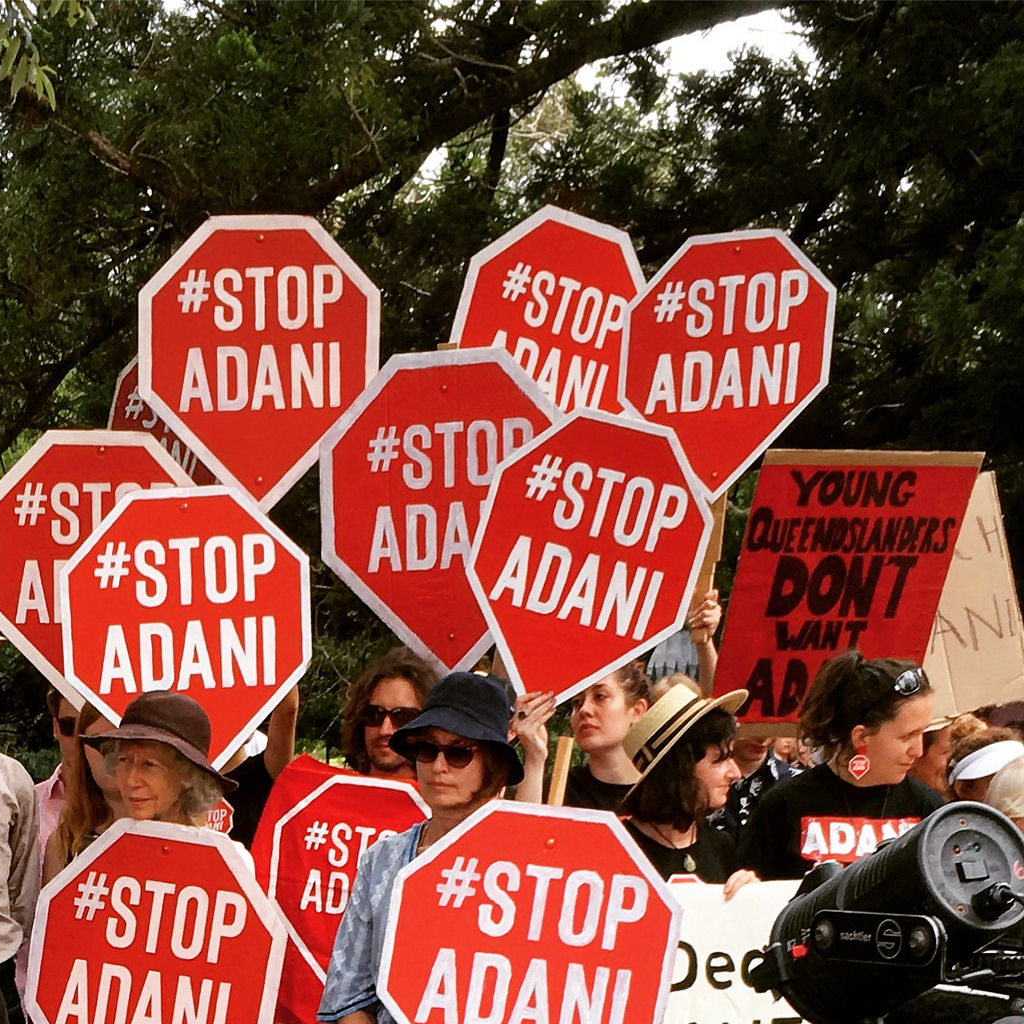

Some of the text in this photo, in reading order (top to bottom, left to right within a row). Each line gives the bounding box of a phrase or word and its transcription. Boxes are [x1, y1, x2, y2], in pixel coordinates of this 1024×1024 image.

[177, 264, 343, 331] #STOP
[502, 261, 629, 349] #STOP
[654, 269, 808, 338] #STOP
[178, 342, 341, 412] ADANI
[491, 329, 609, 412] DANI
[645, 342, 800, 414] ADANI
[14, 482, 176, 545] #ST
[525, 454, 689, 552] #STOP
[791, 470, 917, 508] YOUNG
[94, 533, 276, 608] #STOP
[367, 500, 487, 574] ADA
[490, 535, 664, 642] ADANI
[764, 555, 919, 619] DON'T
[99, 616, 276, 694] ADANI
[776, 620, 868, 651] WANT
[930, 594, 1017, 656] ANI
[207, 808, 228, 822] TOP
[304, 820, 397, 869] #ST
[73, 870, 248, 964] #STOP
[436, 856, 649, 952] #STOP
